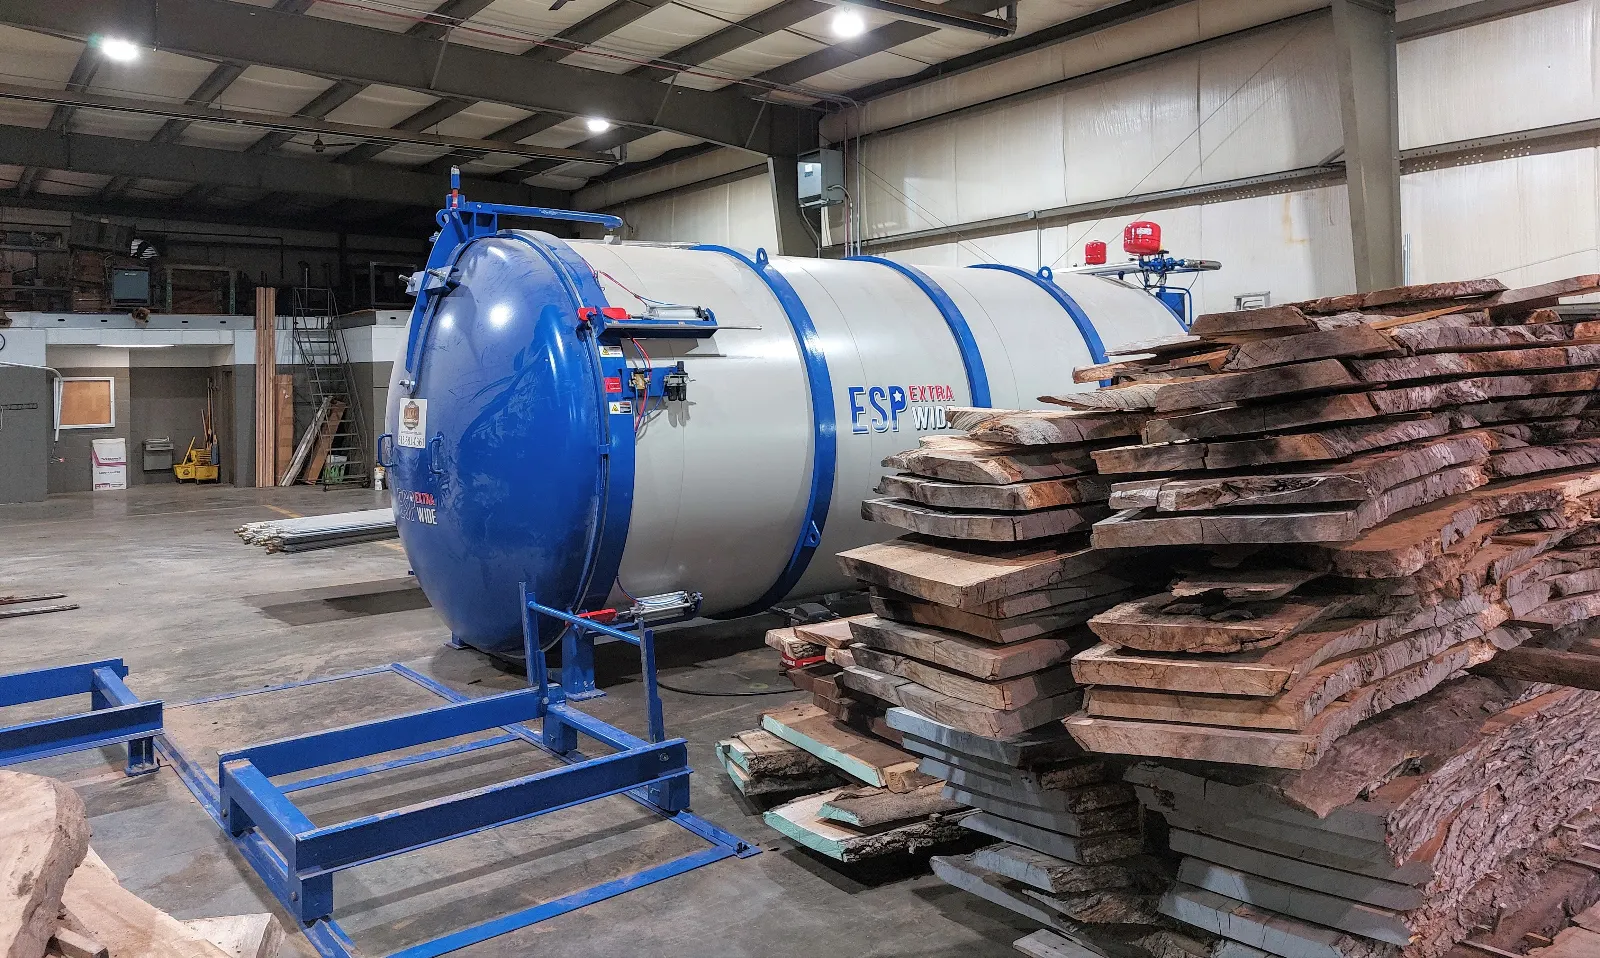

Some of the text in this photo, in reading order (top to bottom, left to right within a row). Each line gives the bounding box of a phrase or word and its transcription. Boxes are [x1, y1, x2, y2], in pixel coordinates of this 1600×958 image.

[908, 384, 955, 402] EXTRA
[847, 384, 908, 434] ESP
[414, 491, 436, 506] EXTRA
[416, 506, 438, 525] WIDE
